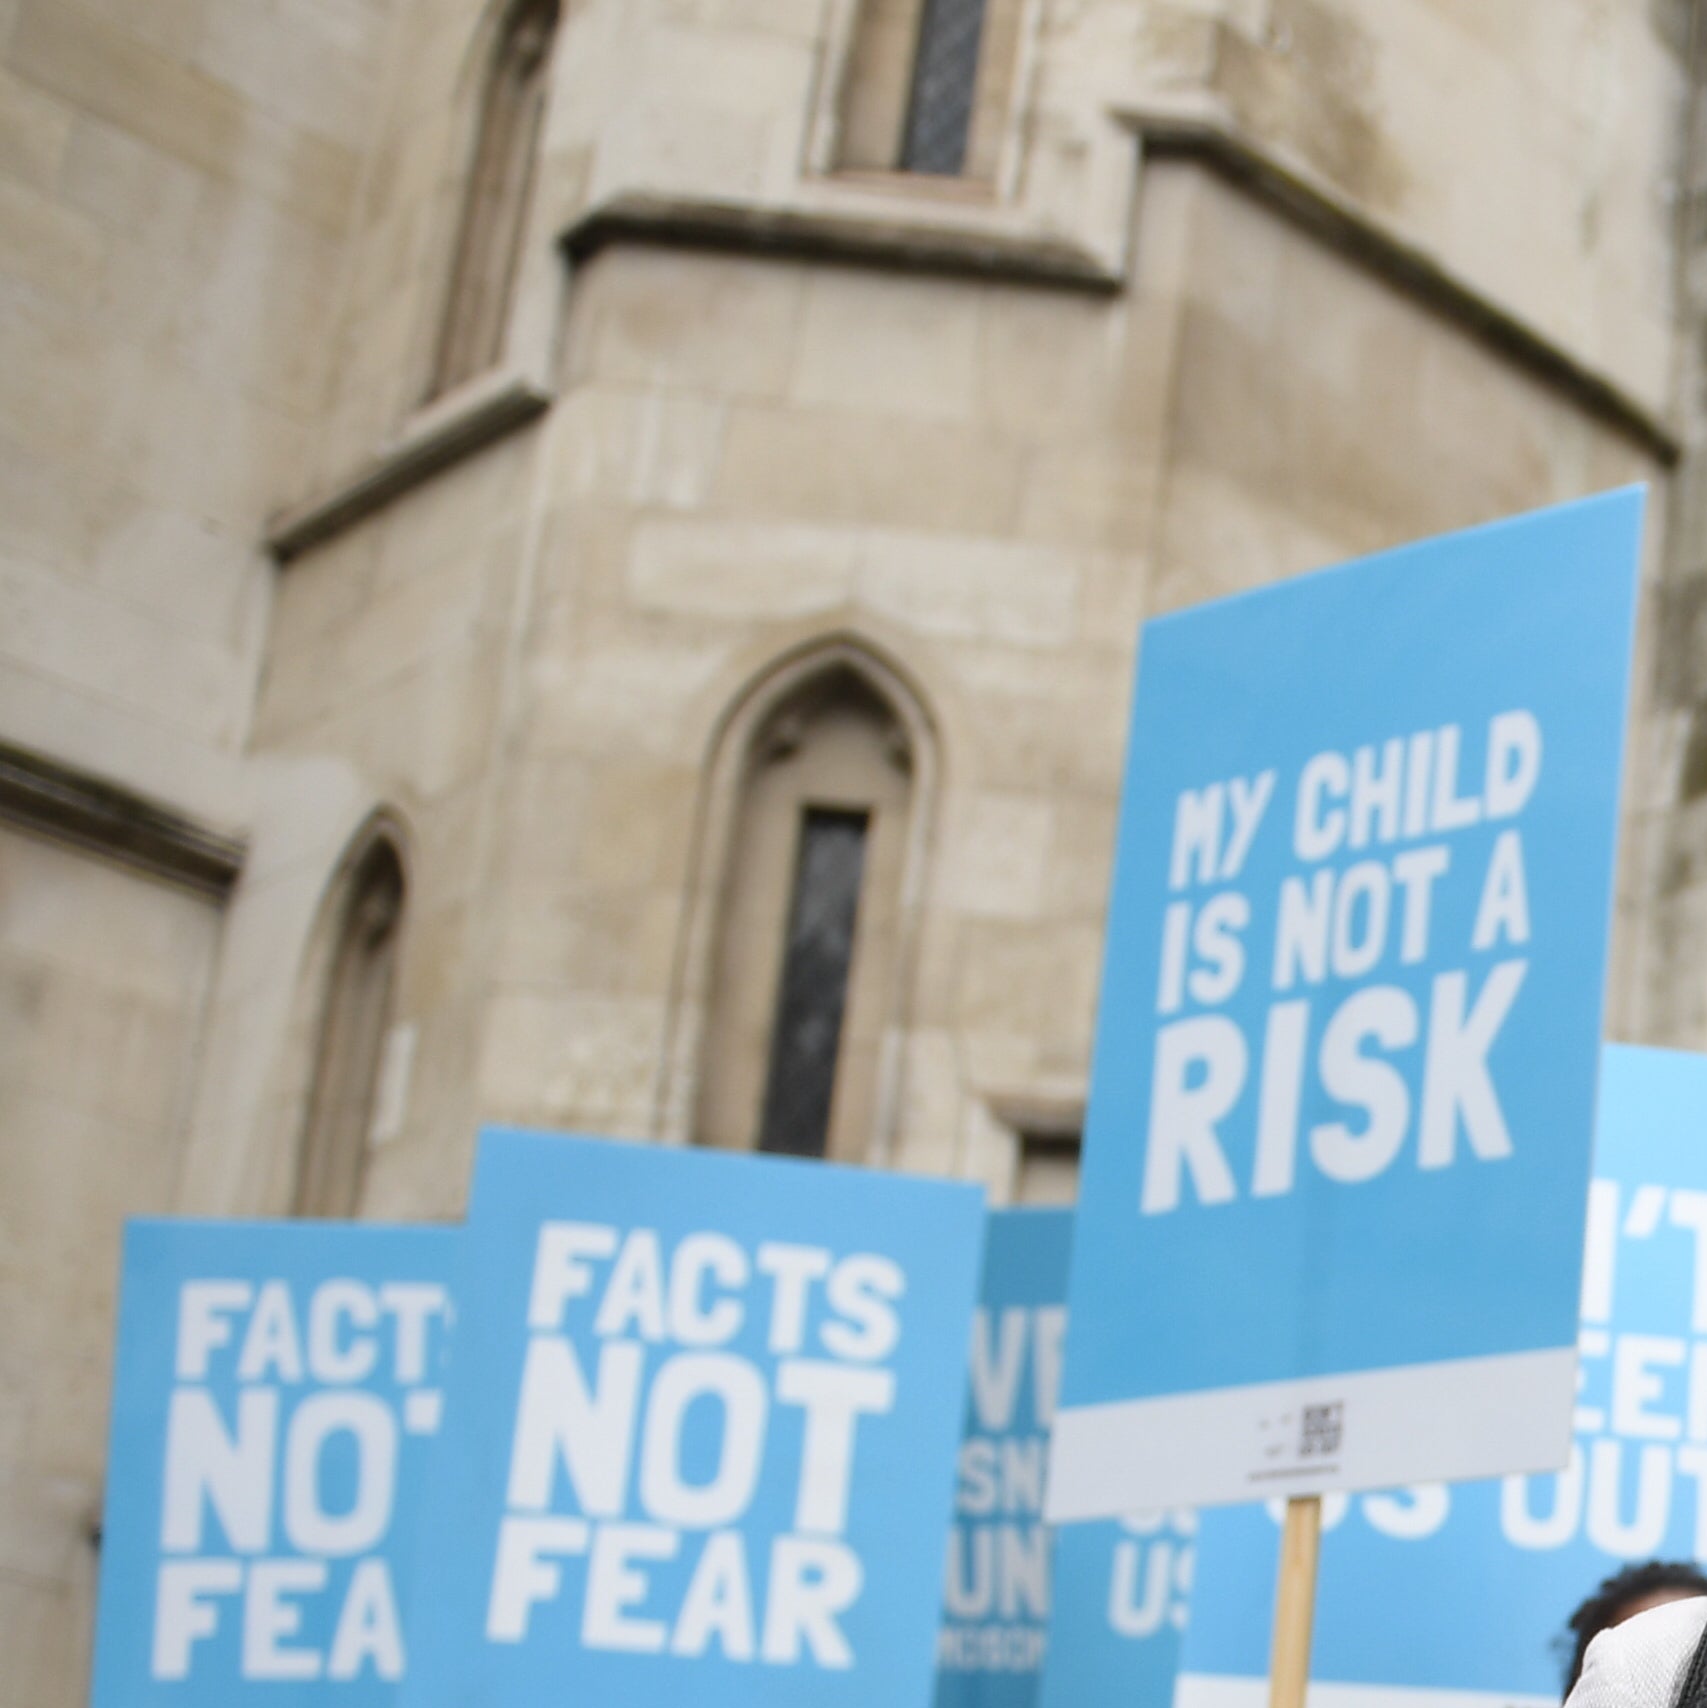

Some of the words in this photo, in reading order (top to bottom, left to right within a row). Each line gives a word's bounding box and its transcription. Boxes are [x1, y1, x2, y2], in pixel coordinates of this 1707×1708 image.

[1169, 769, 1277, 892] MY
[1292, 708, 1542, 862] CHILD
[1156, 891, 1251, 1016] IS
[1271, 845, 1450, 992] NOT
[1471, 829, 1530, 952] A
[1140, 959, 1529, 1216] RISK
[174, 1279, 455, 1384] FACT
[526, 1220, 906, 1362] FACTS
[161, 1388, 442, 1555] NO
[505, 1336, 895, 1538] NOT
[151, 1558, 402, 1682] FEA
[485, 1514, 863, 1670] FEAR
